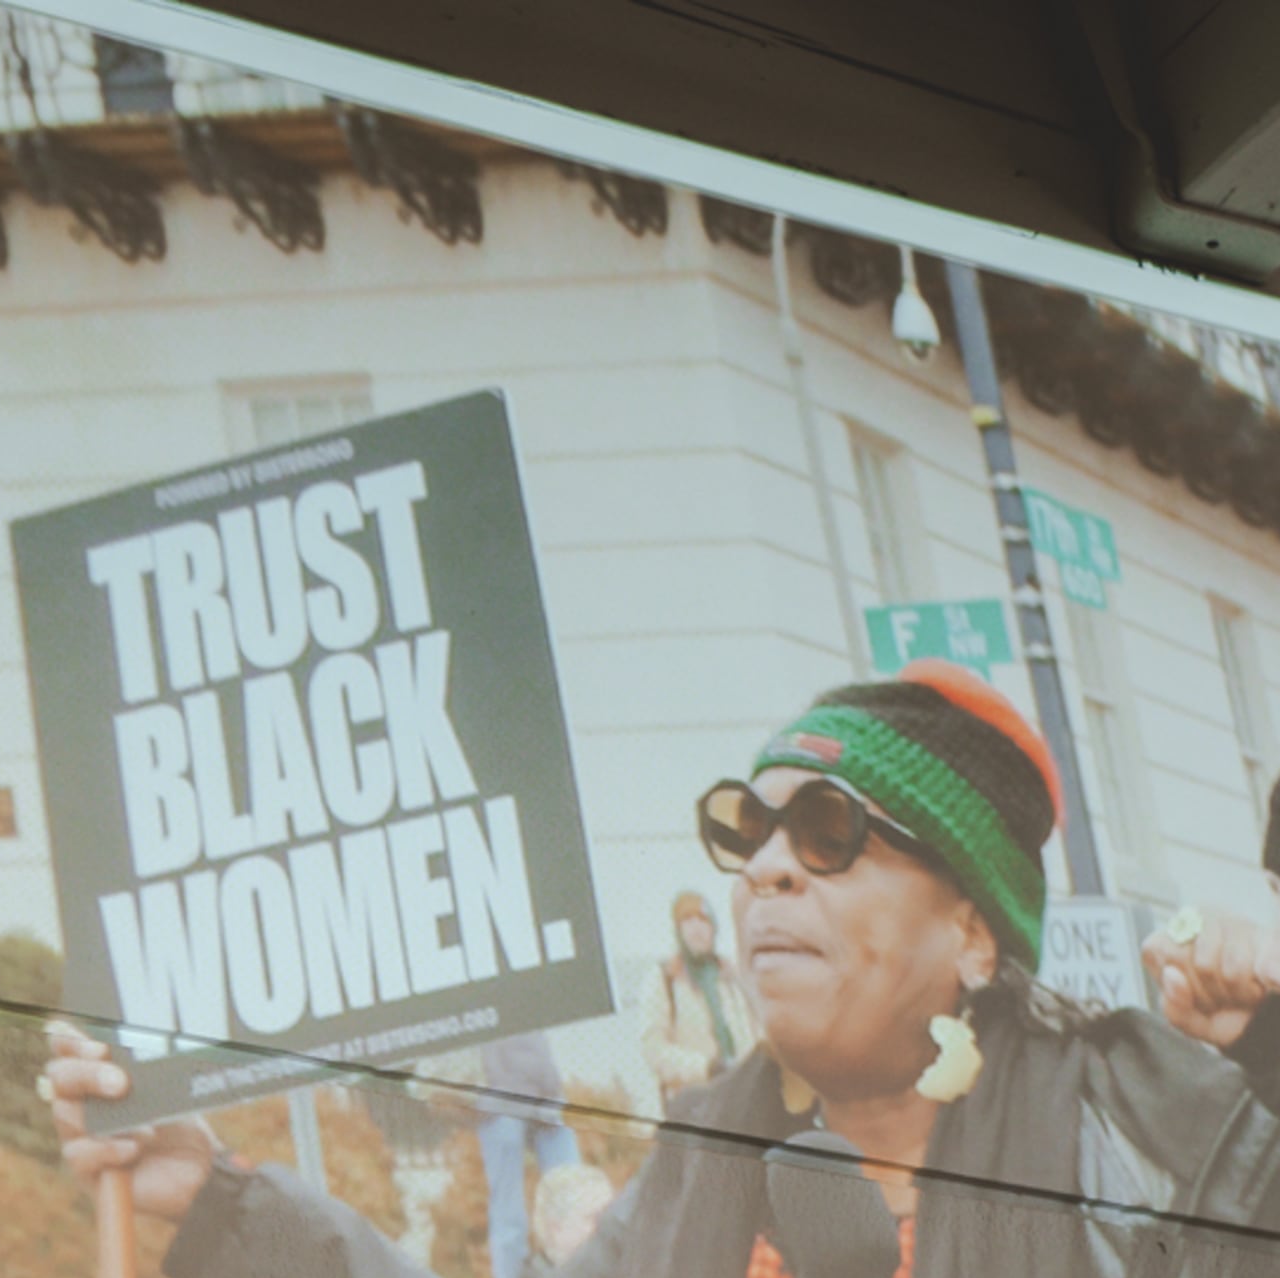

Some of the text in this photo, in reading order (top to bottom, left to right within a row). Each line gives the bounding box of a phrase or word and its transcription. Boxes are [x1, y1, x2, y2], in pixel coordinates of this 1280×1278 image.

[86, 461, 432, 702] TRUST
[889, 610, 920, 663] F
[114, 629, 478, 878] BLACK
[99, 795, 576, 1061] WOMEN.
[1048, 919, 1118, 961] ONE
